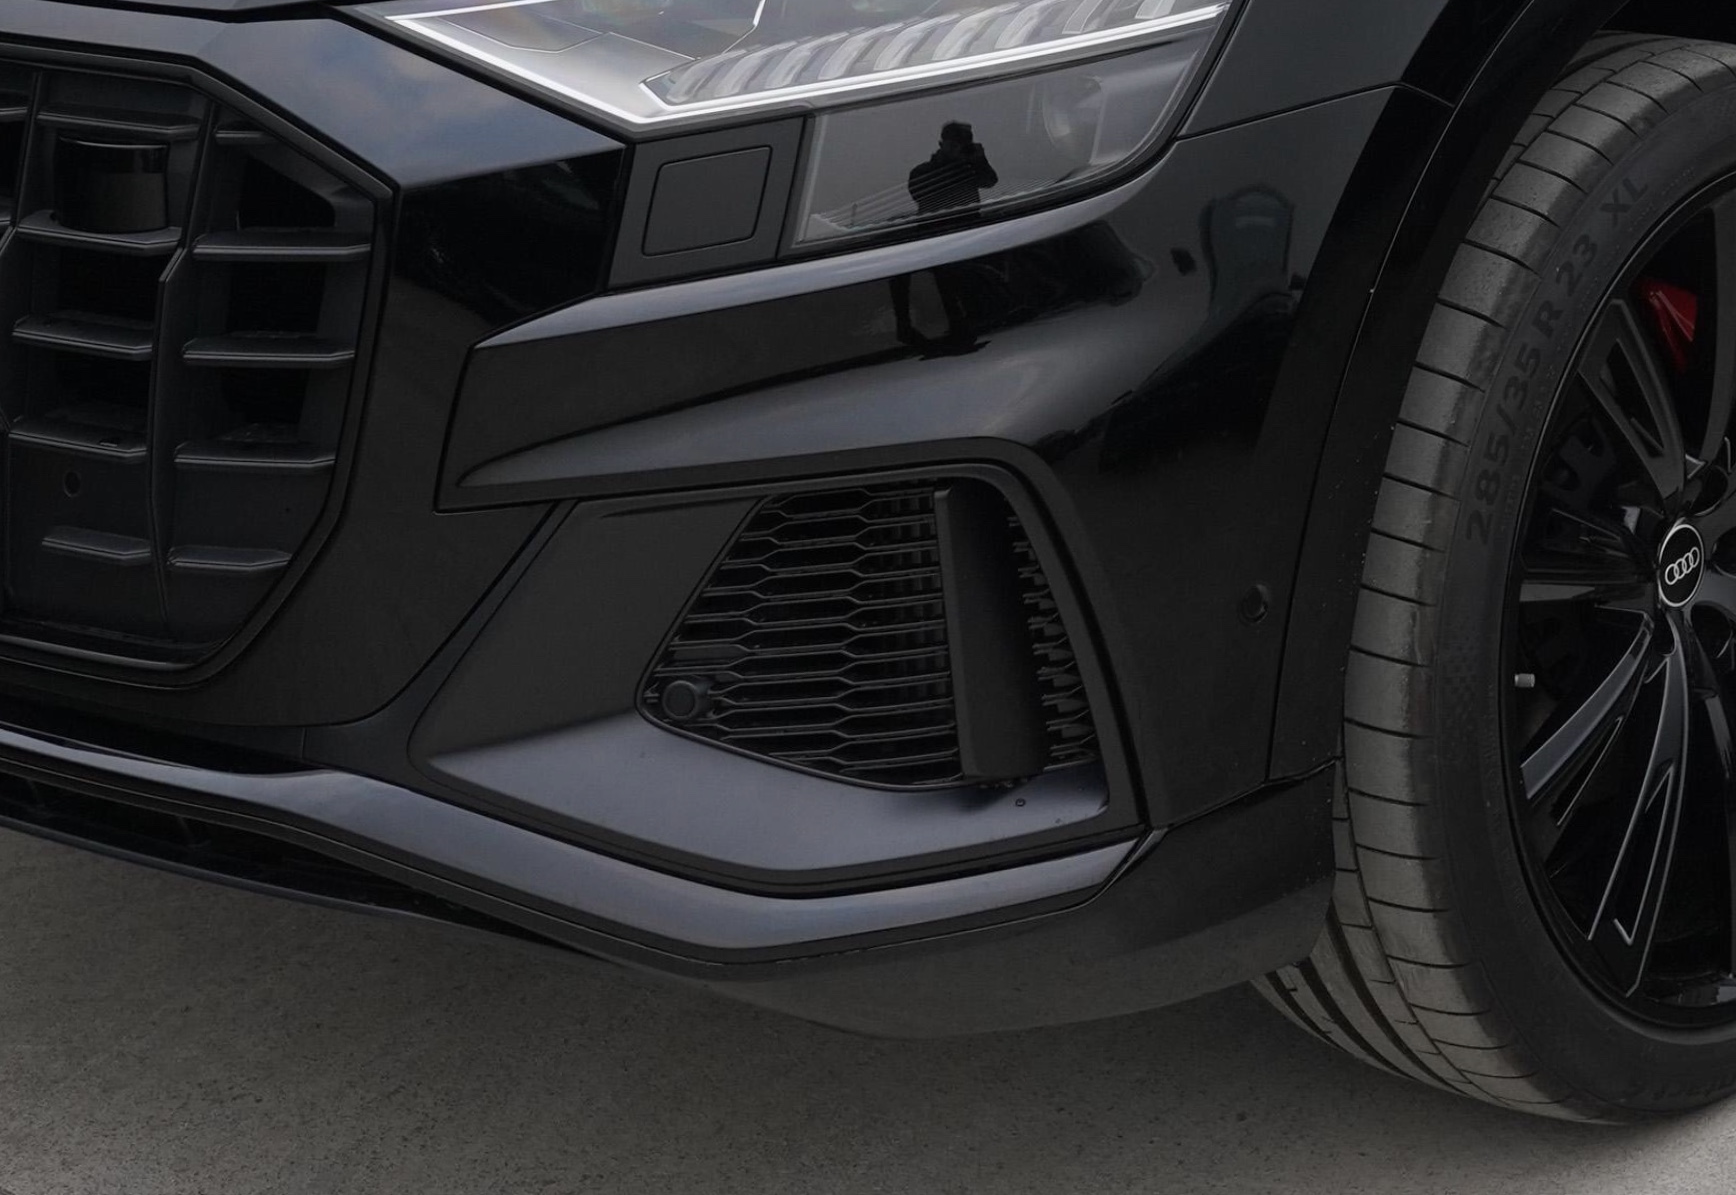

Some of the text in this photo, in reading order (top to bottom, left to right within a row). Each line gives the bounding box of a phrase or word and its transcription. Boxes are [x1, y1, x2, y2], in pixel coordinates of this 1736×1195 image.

[1466, 342, 1541, 544] 285/35
[1555, 234, 1598, 297] 23
[1600, 177, 1648, 227] XL
